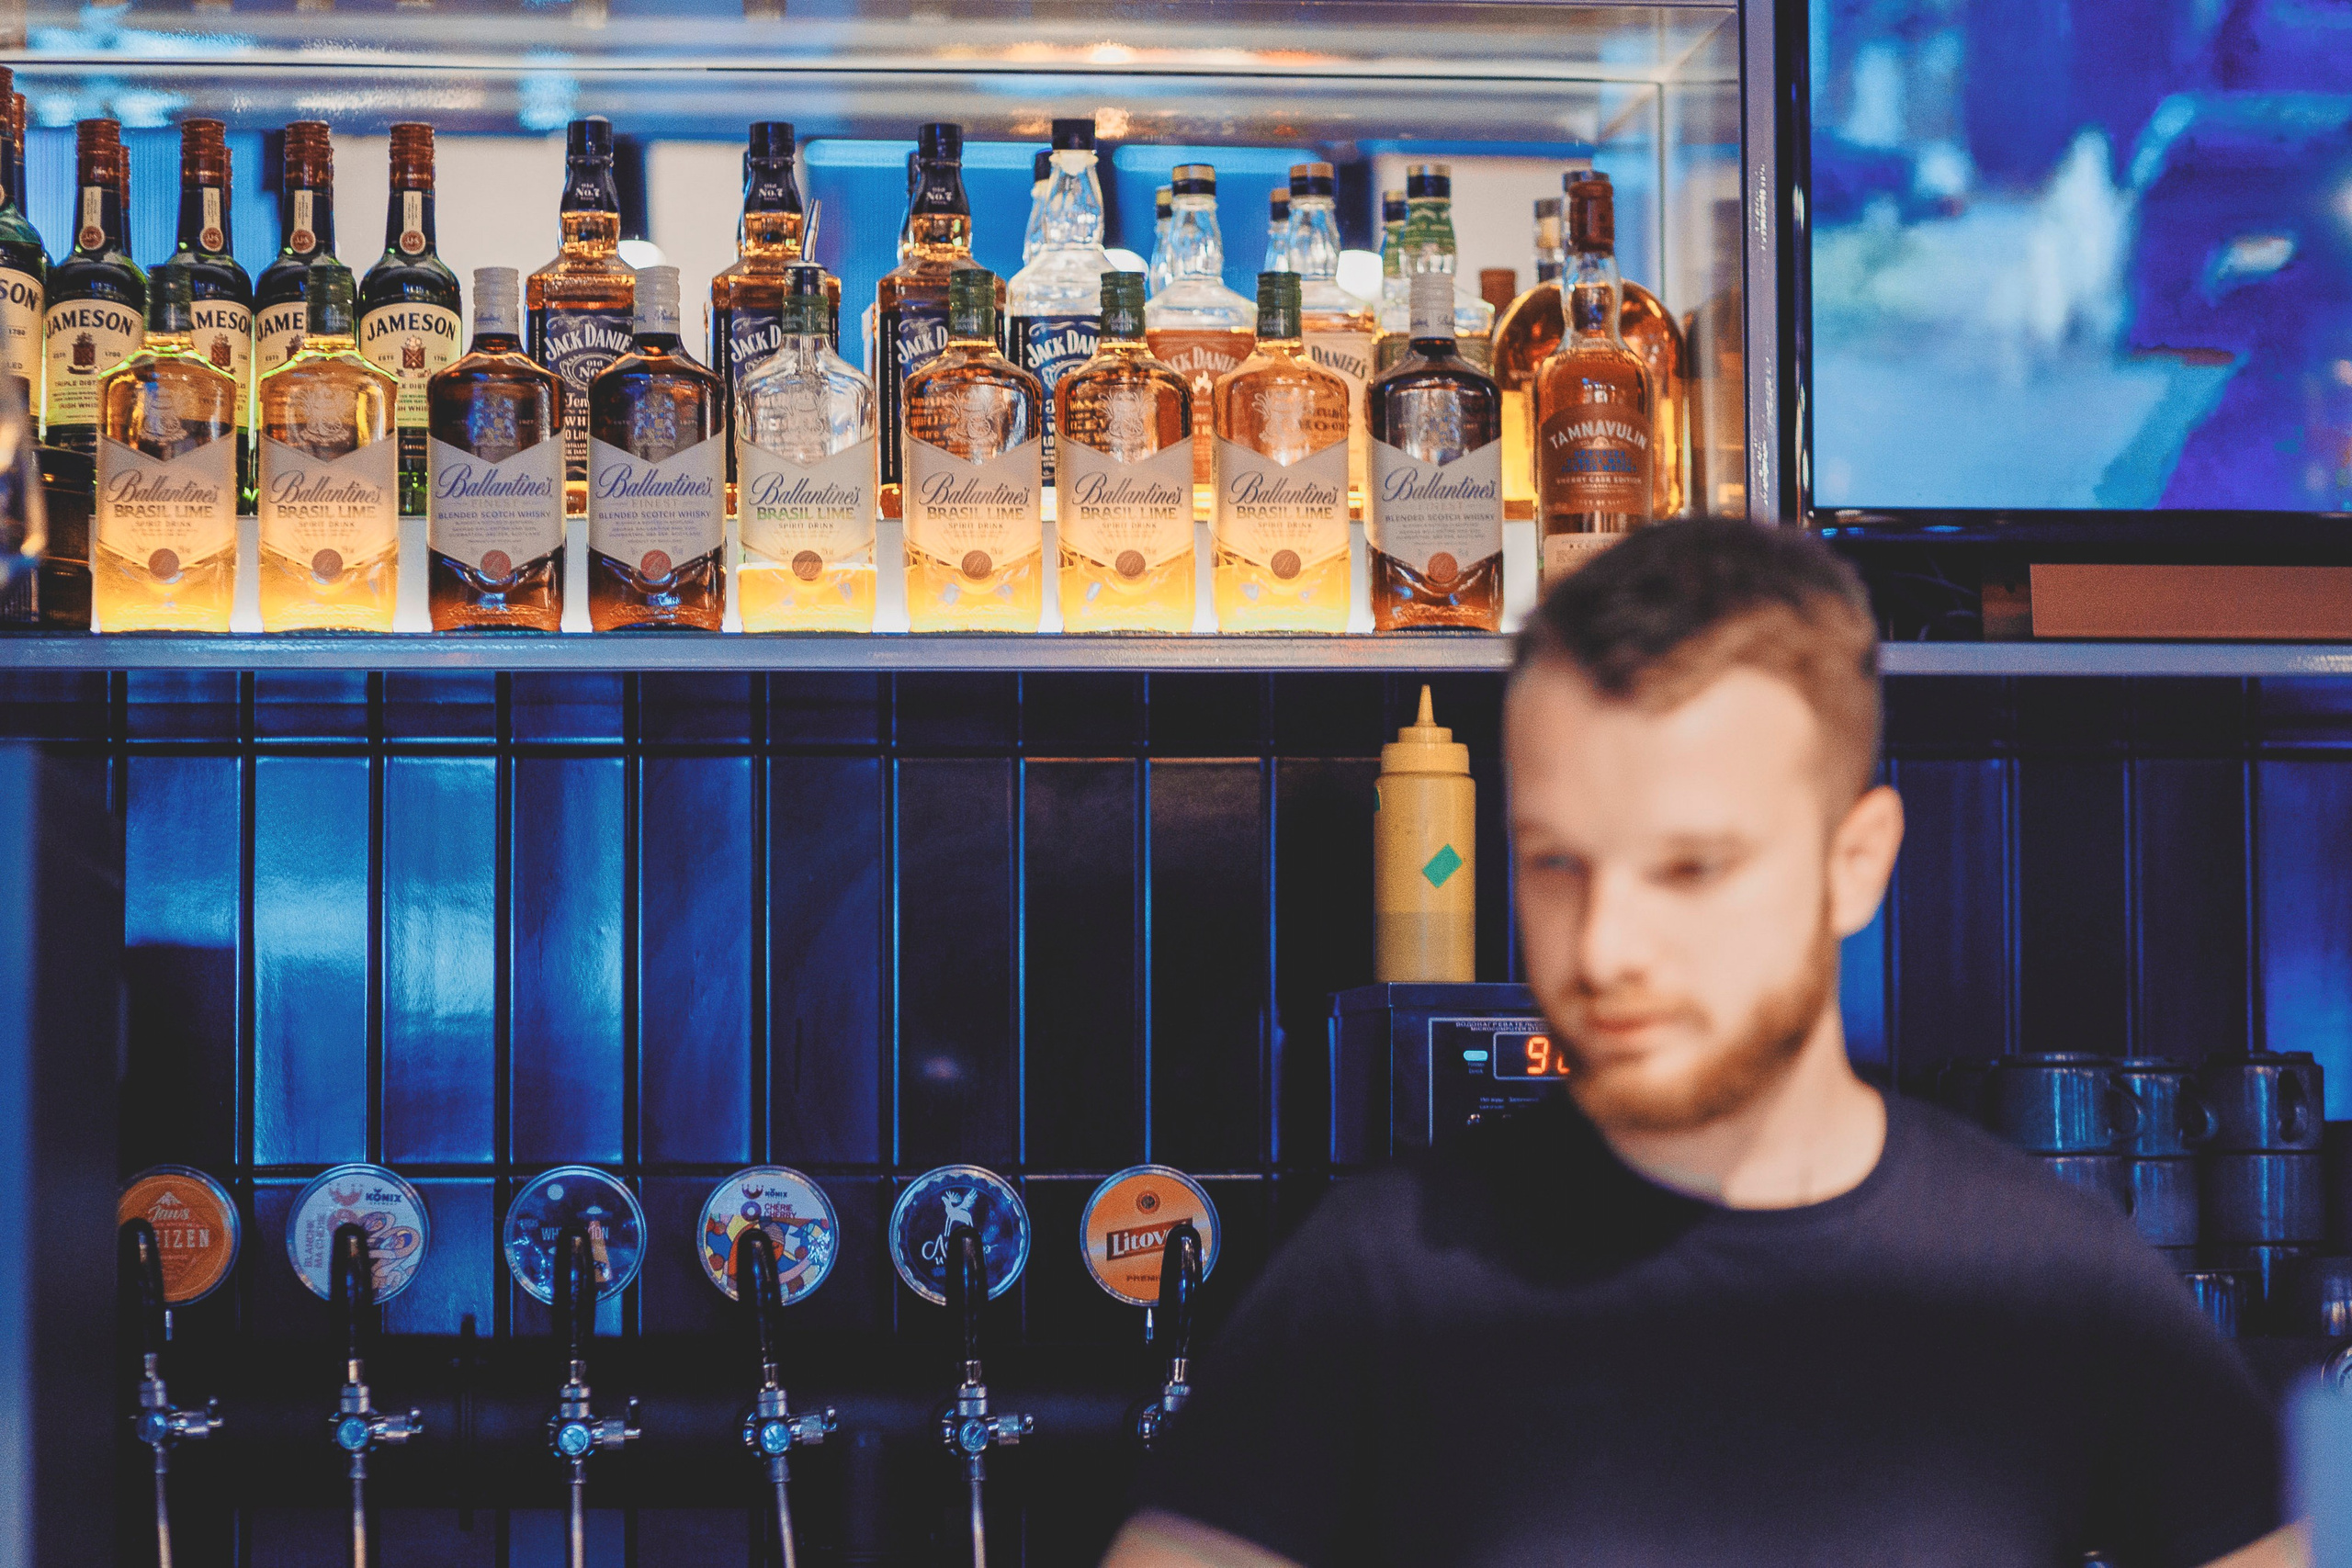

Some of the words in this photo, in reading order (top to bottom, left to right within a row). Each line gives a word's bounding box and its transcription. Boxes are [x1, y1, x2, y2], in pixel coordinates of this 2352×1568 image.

[46, 308, 134, 339] JAMESON
[191, 309, 251, 341] MESON
[256, 311, 304, 343] JAME
[367, 311, 457, 342] JAMESON
[543, 330, 582, 361] JACK
[583, 321, 633, 354] DANIE
[729, 330, 769, 364] JACK
[896, 332, 933, 364] JACK
[1025, 333, 1066, 367] JACK
[1549, 419, 1648, 450] TAMNAVULIN
[106, 468, 220, 503] Ballantine's
[269, 469, 382, 504] Ballantine's
[435, 462, 553, 499] Ballantine's
[595, 462, 713, 499] Ballantine's
[748, 471, 861, 506] Ballantine's
[918, 471, 1030, 506] Ballantine's
[1071, 471, 1183, 505] Ballantine's
[1227, 470, 1340, 505] Ballantine's
[1381, 466, 1497, 502] Ballantine's
[114, 504, 173, 518] BRASIL
[175, 505, 214, 518] LIME
[277, 505, 334, 519] BRASIL
[338, 505, 377, 519] LIME
[437, 512, 478, 520] BLENDED
[481, 511, 515, 519] SCOTCH
[517, 510, 551, 519] WHISKY
[598, 512, 639, 520] BLENDED
[640, 511, 675, 519] SCOTCH
[678, 510, 711, 519] WHISKY
[756, 506, 814, 521] BRASIL
[817, 507, 856, 520] LIME
[926, 506, 984, 521] BRASIL
[987, 507, 1025, 521] LIME
[1080, 506, 1137, 521] BRASIL
[1140, 507, 1179, 520] LIME
[1236, 506, 1294, 520] BRASIL
[1296, 507, 1334, 520] LIME
[1113, 1230, 1168, 1257] Litov
